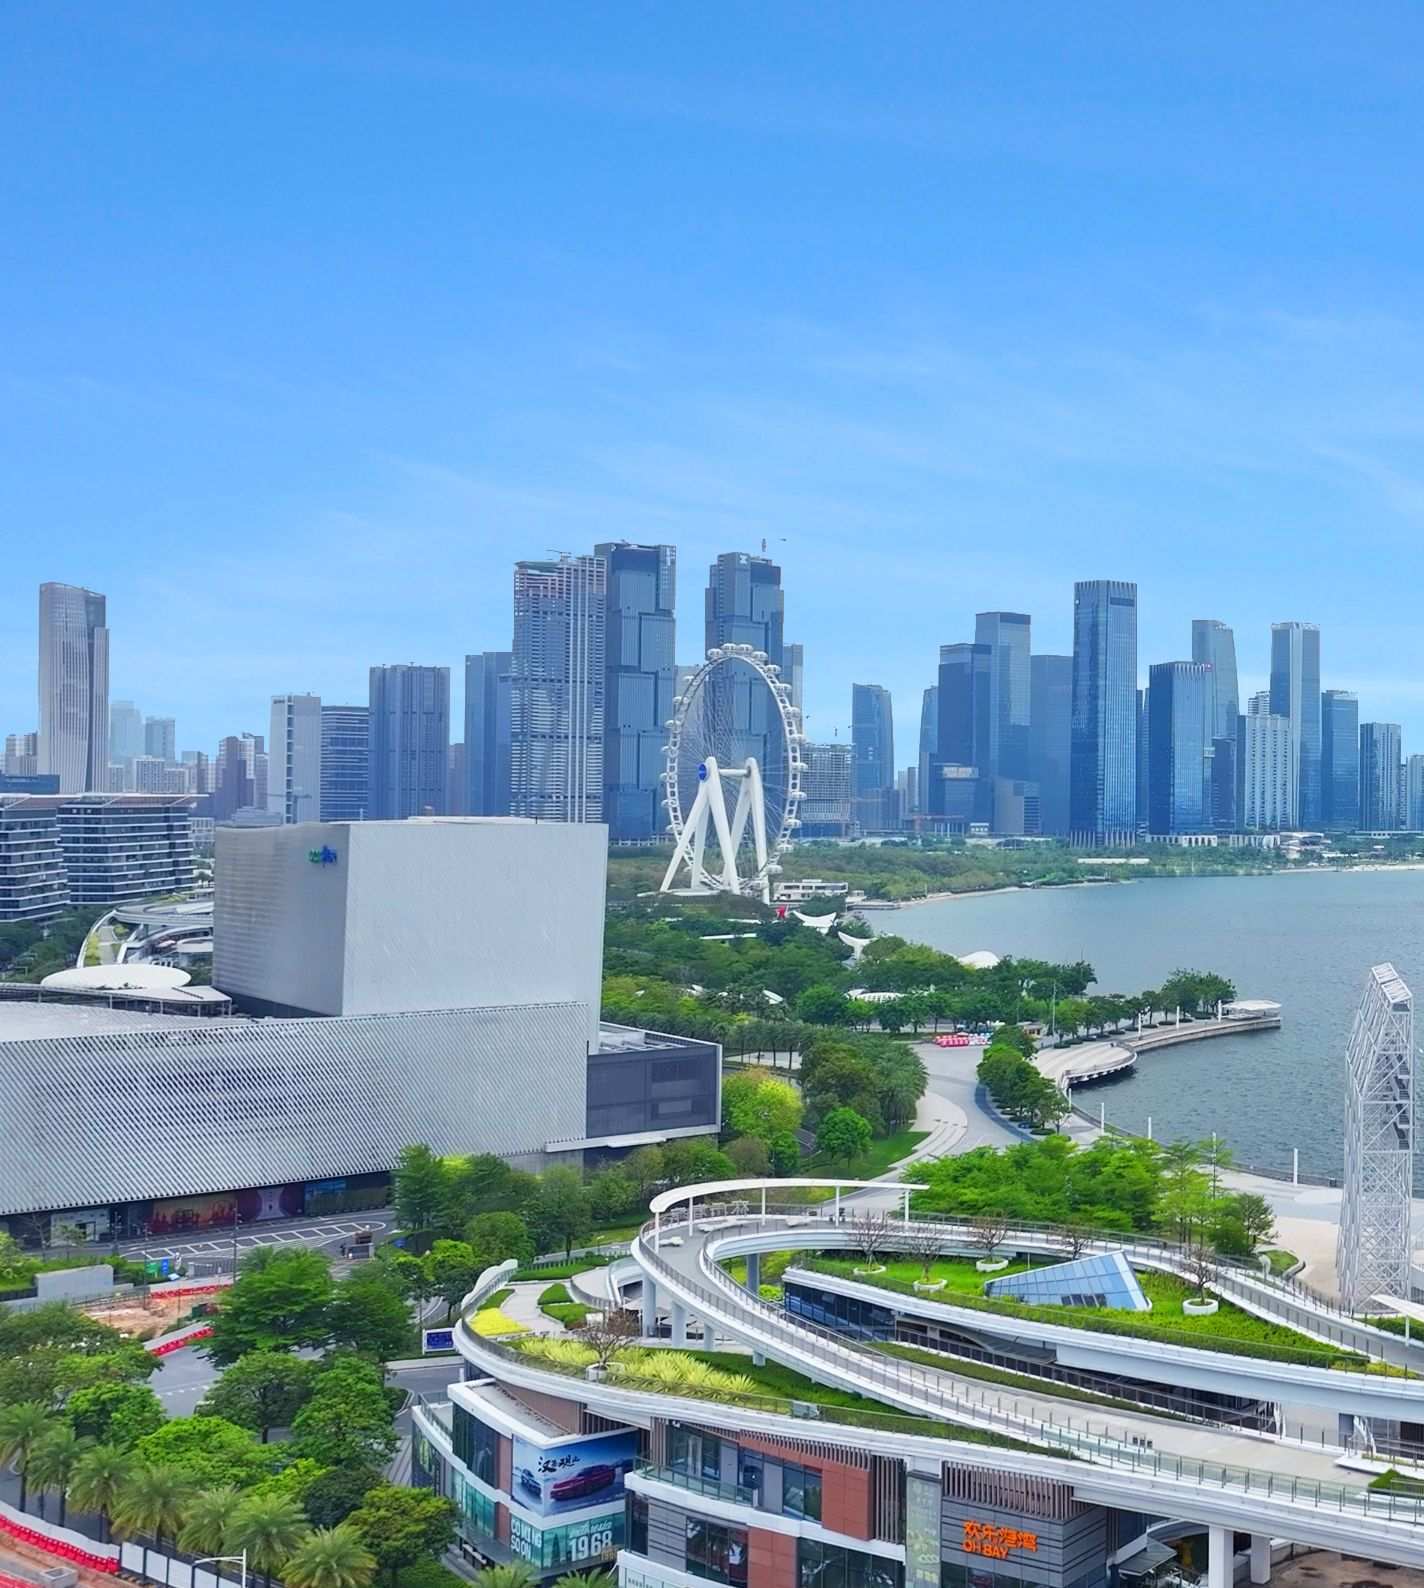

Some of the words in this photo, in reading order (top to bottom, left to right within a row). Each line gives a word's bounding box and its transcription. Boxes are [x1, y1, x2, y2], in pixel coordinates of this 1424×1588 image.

[511, 1535, 537, 1560] SOON
[568, 1531, 613, 1562] 1968
[963, 1520, 1039, 1552] 欢乐港湾
[963, 1539, 981, 1553] OH
[982, 1543, 1008, 1559] BAY
